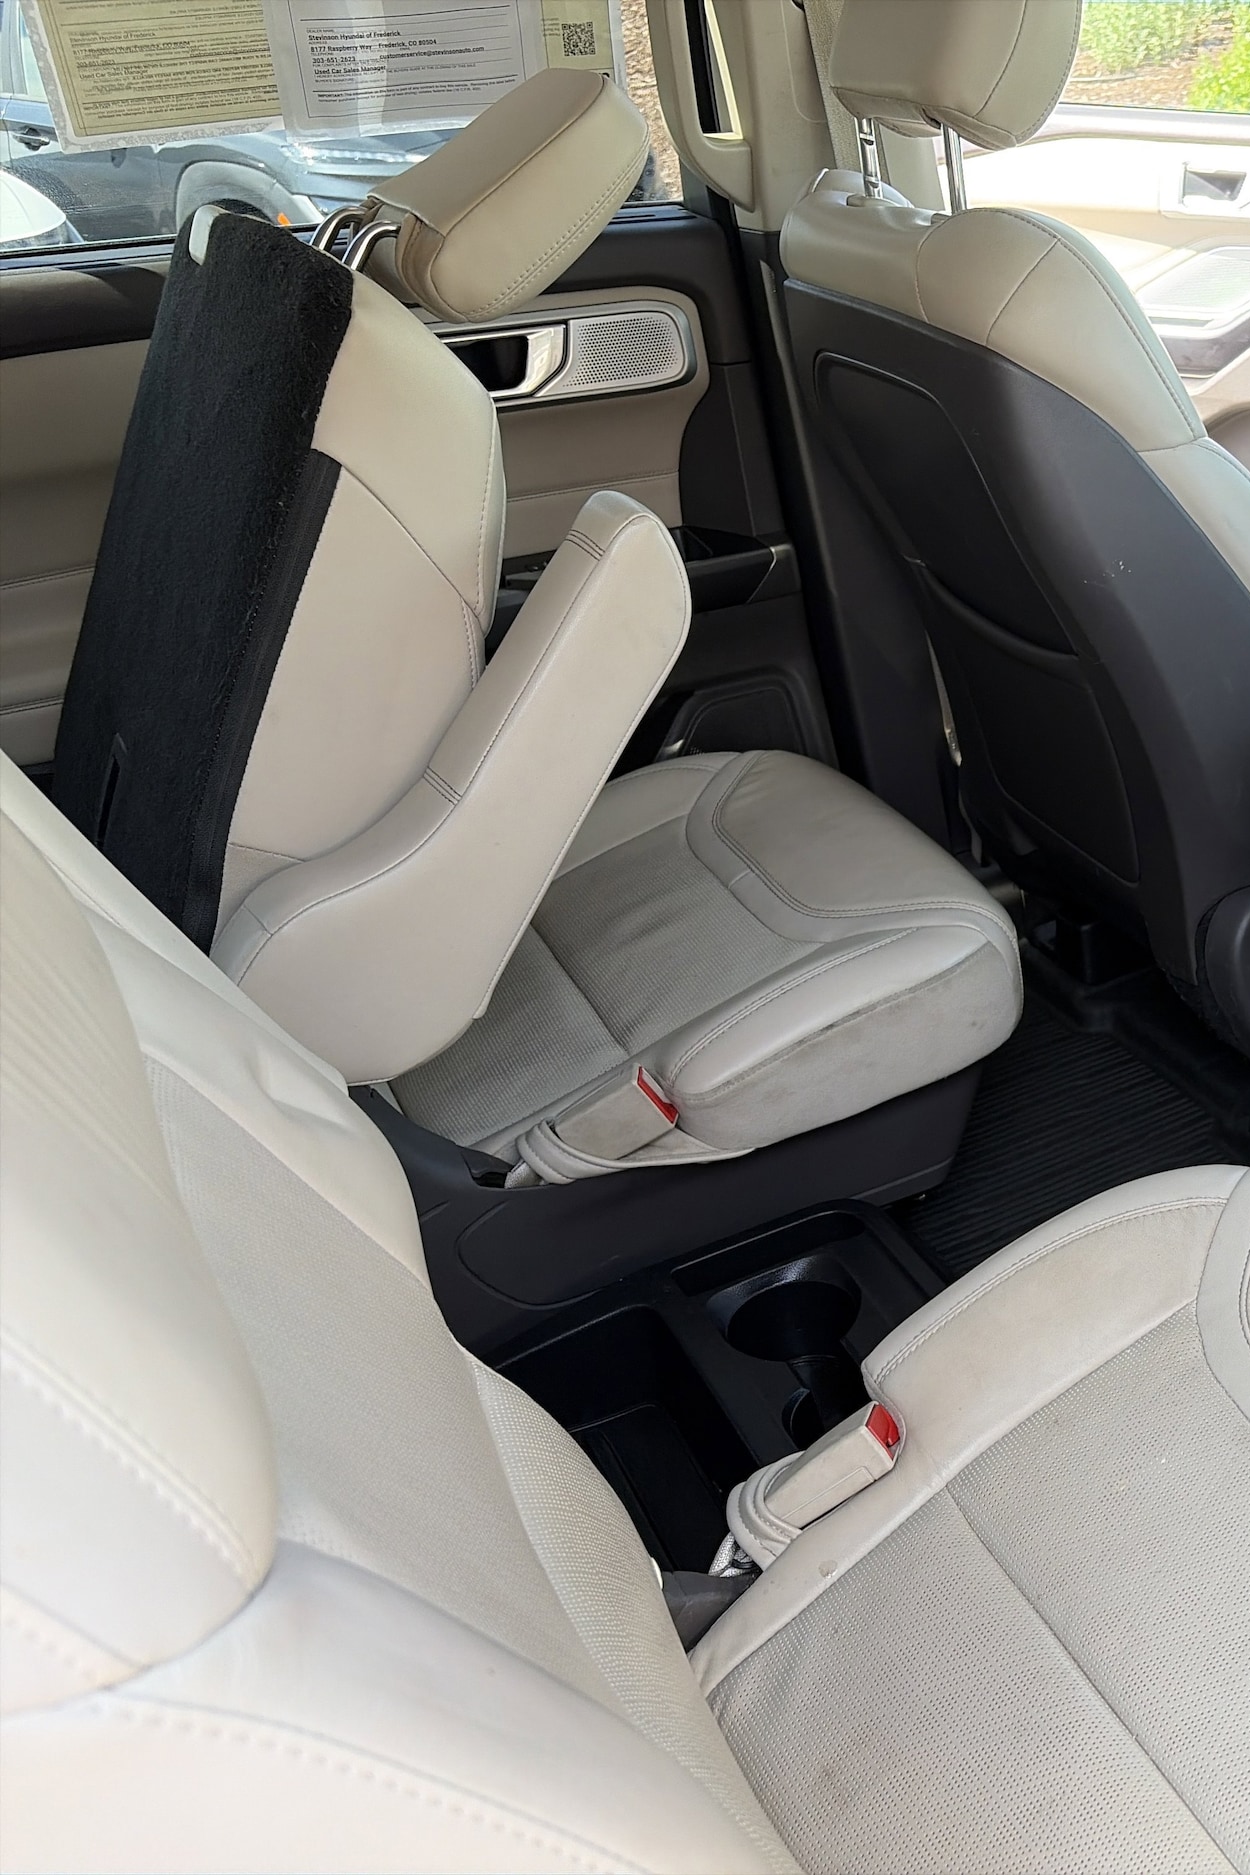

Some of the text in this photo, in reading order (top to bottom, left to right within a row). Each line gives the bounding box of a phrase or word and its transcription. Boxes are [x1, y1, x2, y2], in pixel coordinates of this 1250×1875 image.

[339, 32, 365, 40] Hyundai
[373, 30, 401, 38] Frederick
[327, 44, 358, 52] Raspberry
[378, 41, 408, 49] Frederick,
[379, 46, 485, 60] customerservice@stevinsonauto.com
